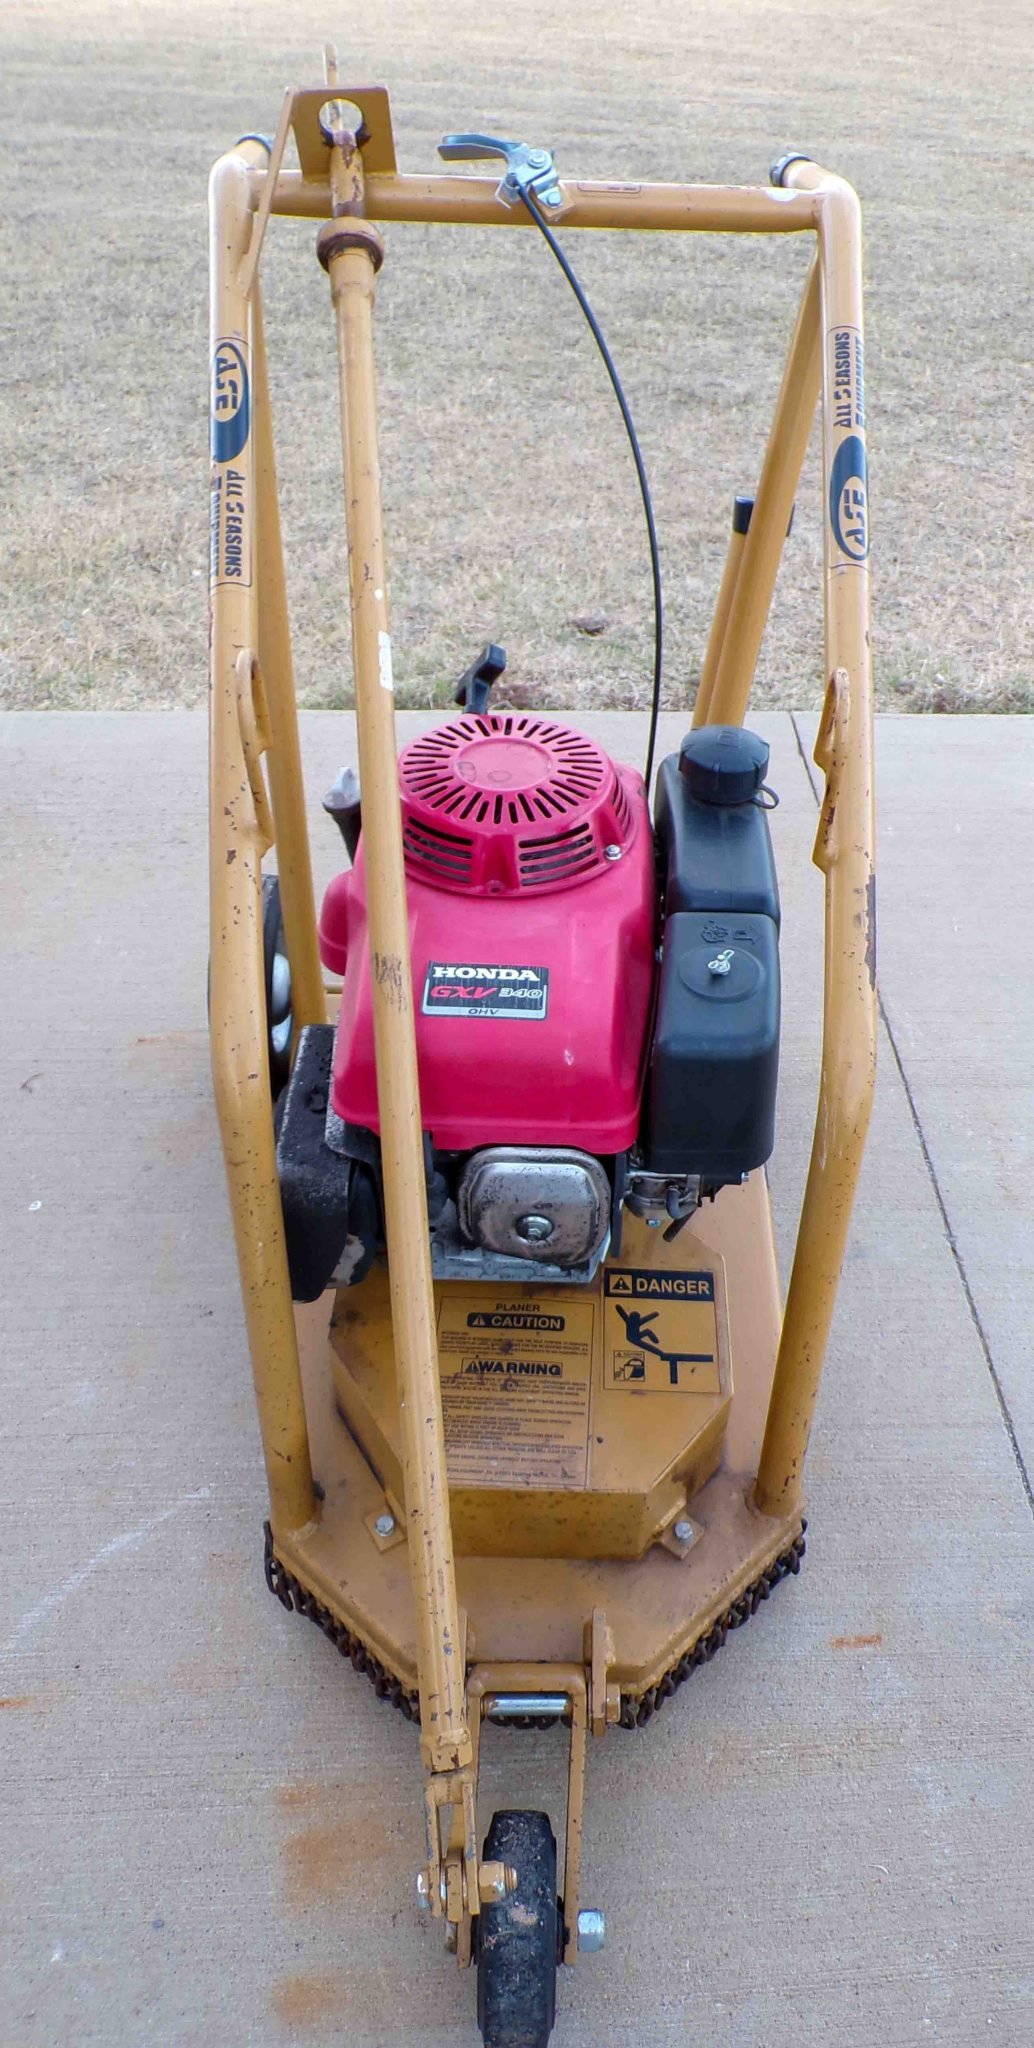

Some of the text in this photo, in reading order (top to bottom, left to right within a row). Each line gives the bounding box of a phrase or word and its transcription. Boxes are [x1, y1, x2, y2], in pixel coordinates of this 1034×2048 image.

[215, 357, 238, 411] ASE
[833, 332, 851, 429] ALL SEASONS
[224, 469, 246, 577] ALL SEASONS
[843, 488, 865, 549] ASE
[432, 966, 540, 981] HONDA
[430, 985, 543, 999] GXV 340
[636, 1277, 711, 1295] DANGER
[495, 1303, 541, 1312] PLANER
[491, 1315, 562, 1330] CAUTION
[478, 1360, 561, 1376] WARNING
